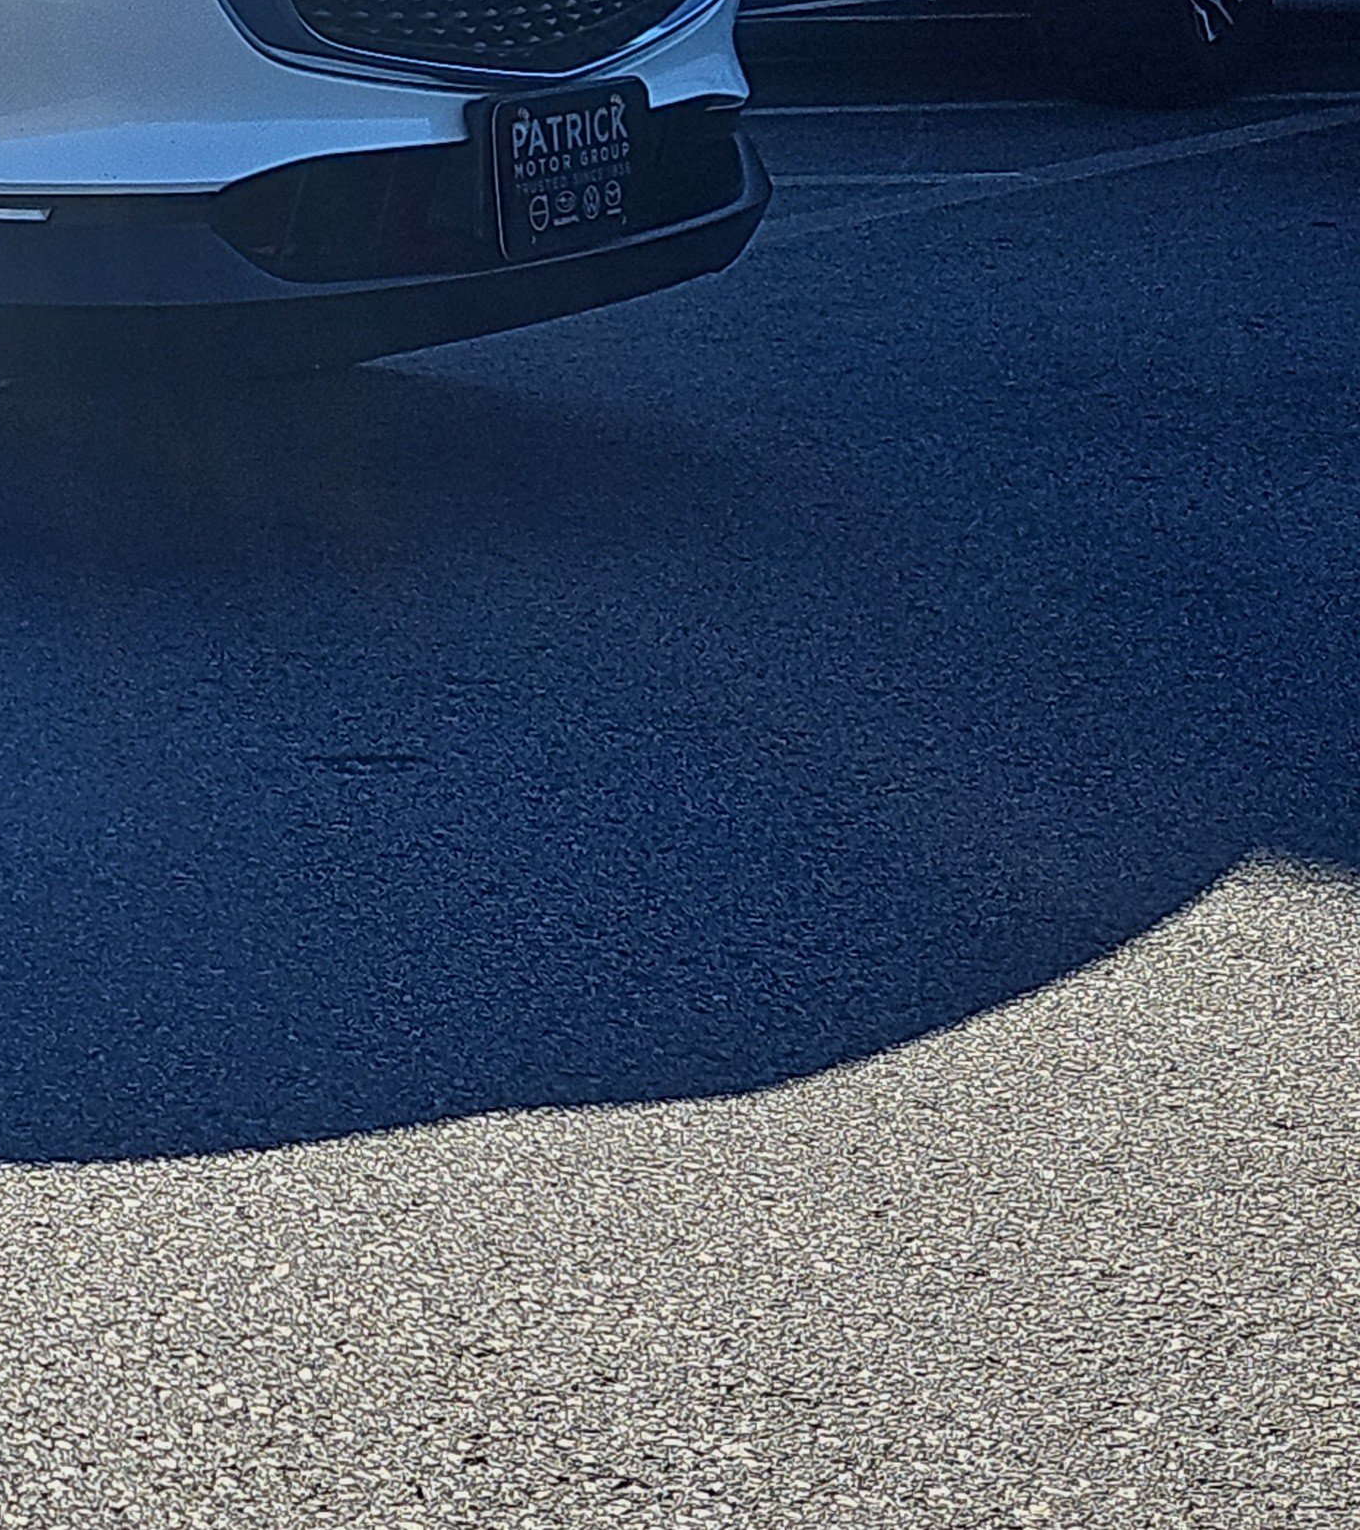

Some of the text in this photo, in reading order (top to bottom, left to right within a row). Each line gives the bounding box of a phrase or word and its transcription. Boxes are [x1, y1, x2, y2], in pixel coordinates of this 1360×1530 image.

[512, 104, 628, 159] PATRICK
[514, 141, 631, 179] MOTOR GROUP
